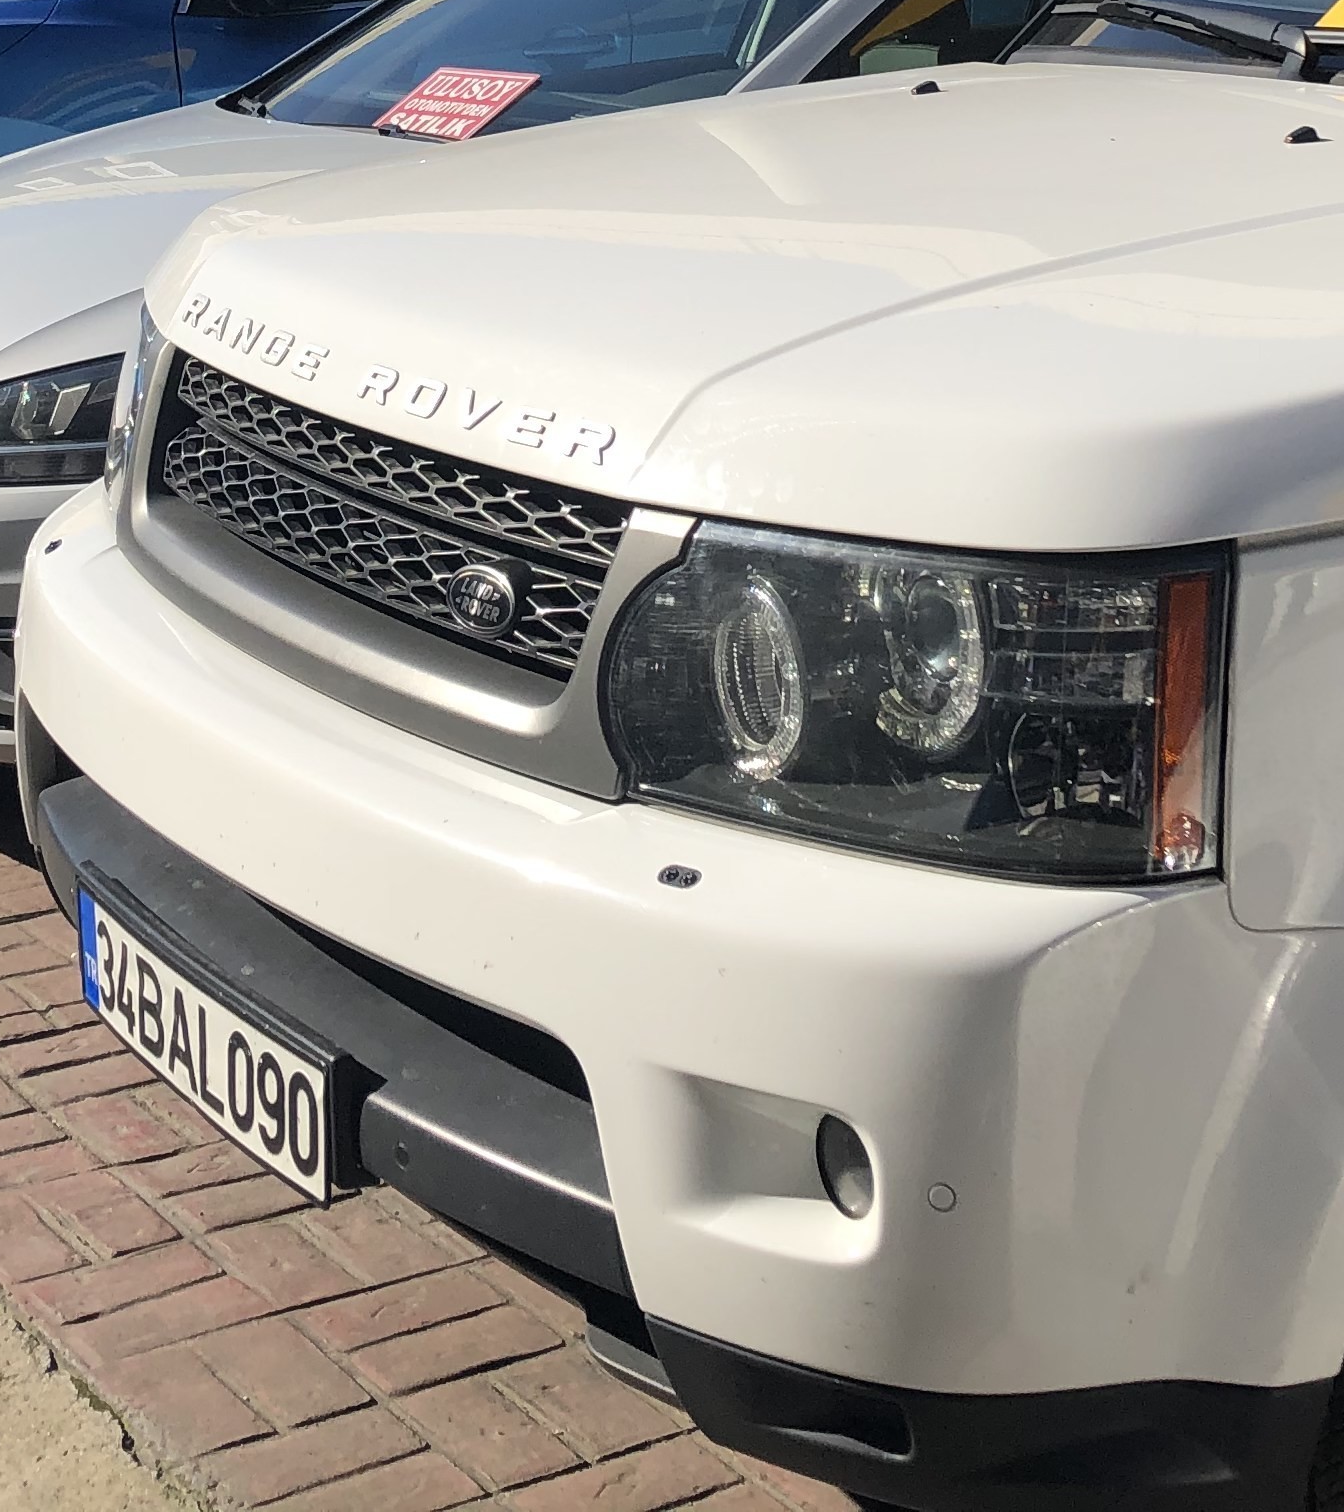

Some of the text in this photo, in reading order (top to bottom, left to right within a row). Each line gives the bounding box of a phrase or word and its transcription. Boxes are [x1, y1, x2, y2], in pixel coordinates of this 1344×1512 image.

[422, 74, 522, 102] ULUSOY
[180, 291, 616, 465] RANGE ROVER
